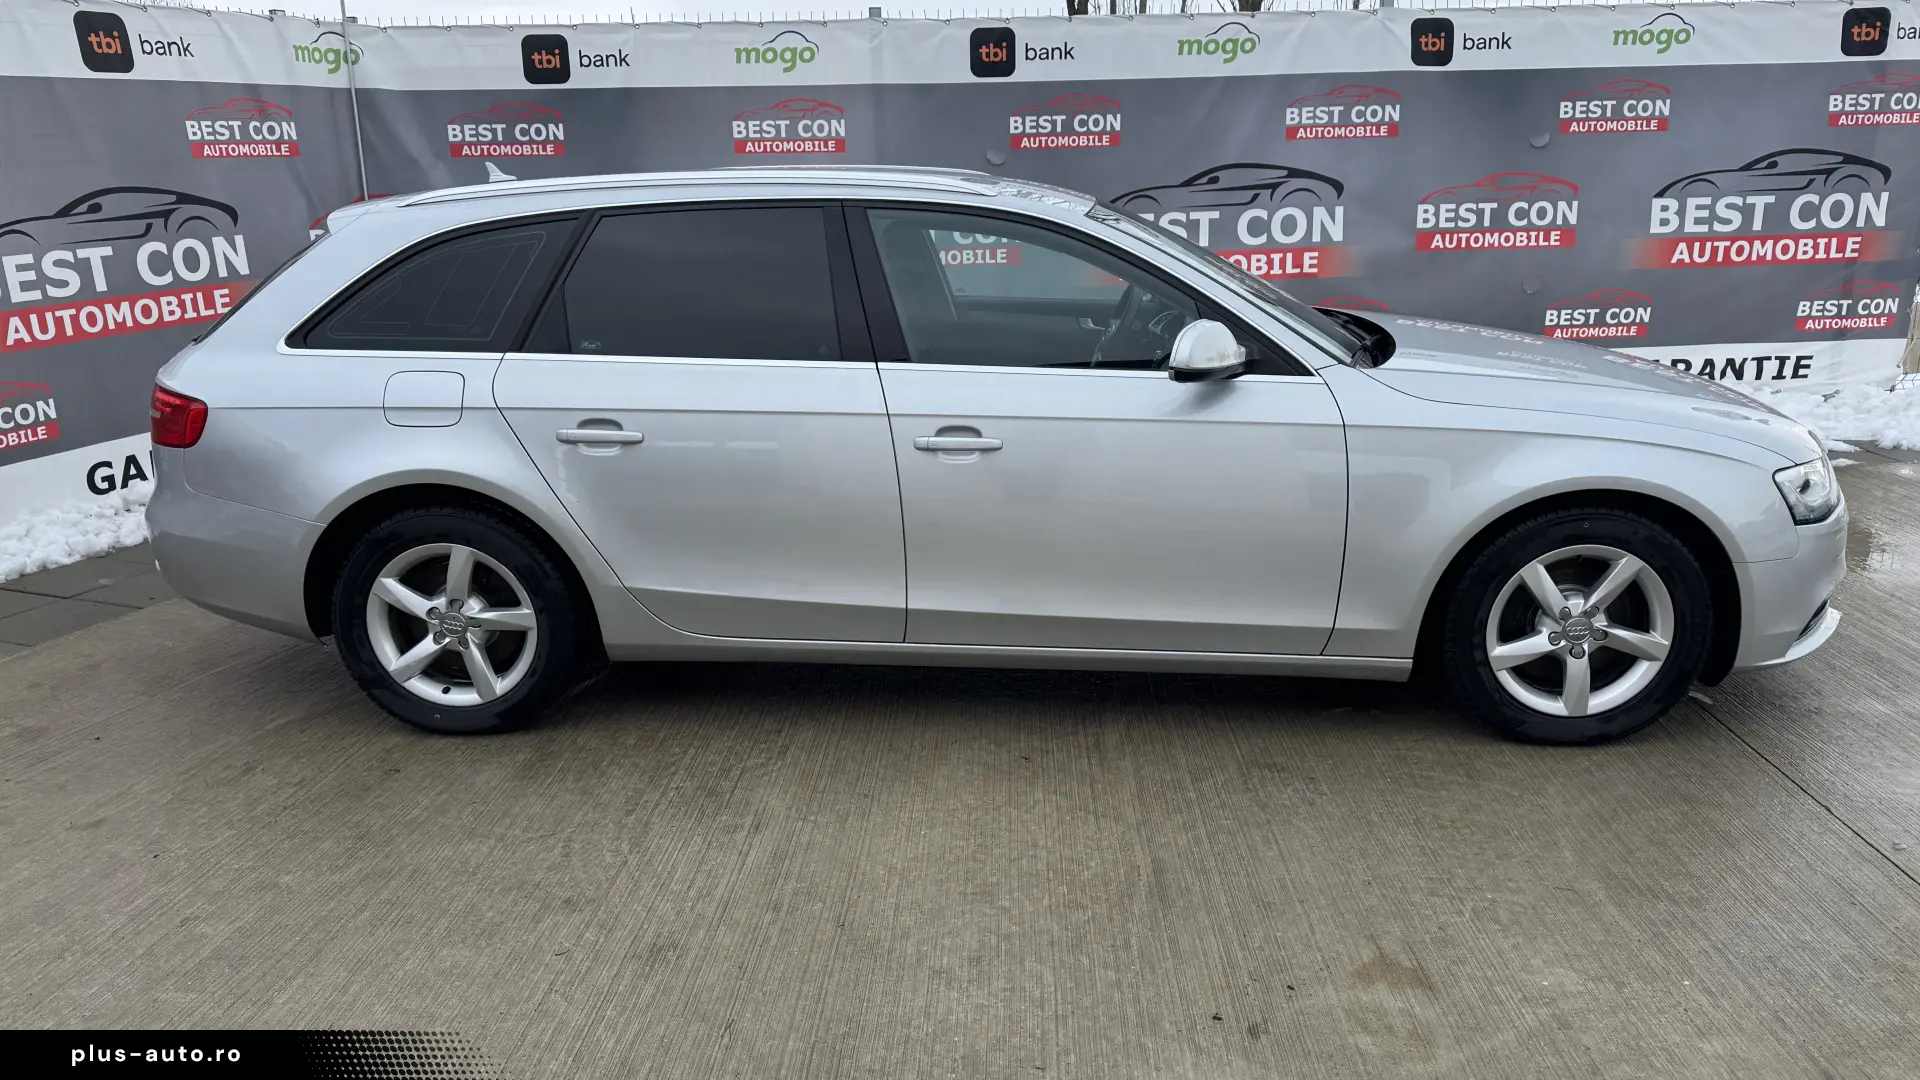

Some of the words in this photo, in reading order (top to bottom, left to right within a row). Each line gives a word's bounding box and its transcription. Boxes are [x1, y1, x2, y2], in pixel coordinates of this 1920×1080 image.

[1419, 33, 1446, 52] tbi
[1462, 32, 1513, 51] bank
[1612, 28, 1692, 54] mogo
[1851, 22, 1882, 42] tbi
[1896, 22, 1920, 40] ba
[87, 31, 122, 55] tbi
[137, 33, 195, 58] bank
[979, 42, 1008, 63] tbi
[1024, 42, 1075, 62] bank
[1176, 37, 1257, 64] mogo
[531, 48, 561, 70] tbi
[578, 49, 630, 69] bank
[734, 45, 815, 73] mogo
[1559, 100, 1617, 119] BEST
[1623, 98, 1671, 117] CON
[1828, 93, 1886, 112] BEST
[1009, 115, 1066, 134] BEST
[1073, 113, 1121, 132] CON
[1285, 106, 1344, 125] BEST
[1350, 104, 1400, 123] CON
[1838, 112, 1920, 126] AUTOMOBILE
[185, 120, 243, 141] BEST
[248, 120, 298, 141] CON
[446, 124, 507, 142] BEST
[514, 123, 565, 141] CON
[731, 120, 790, 139] BEST
[797, 119, 846, 137] CON
[1296, 125, 1388, 139] AUTOMOBILE
[1569, 119, 1659, 133] AUTOMOBILE
[202, 143, 290, 157] AUTOMOBILE
[461, 143, 555, 157] AUTOMOBILE
[744, 139, 836, 153] AUTOMOBILE
[1020, 134, 1110, 148] AUTOMOBILE
[1416, 202, 1498, 229] BEST
[1506, 200, 1579, 227] CON
[1649, 195, 1776, 234] BEST
[1788, 192, 1889, 231] CON
[1236, 206, 1344, 246] CON
[1430, 230, 1561, 249] AUTOMOBILE
[1671, 236, 1862, 264] AUTOMOBILE
[0, 246, 114, 303] EST
[136, 234, 250, 286] CON
[1220, 251, 1319, 275] OBILE
[5, 288, 231, 346] AUTOMOBILE
[1544, 308, 1600, 326] BEST
[1604, 306, 1652, 324] CON
[1796, 299, 1852, 317] BEST
[1857, 297, 1900, 315] CON
[1553, 324, 1638, 338] AUTOMOBILE
[1805, 315, 1889, 330] AUTOMOBILE
